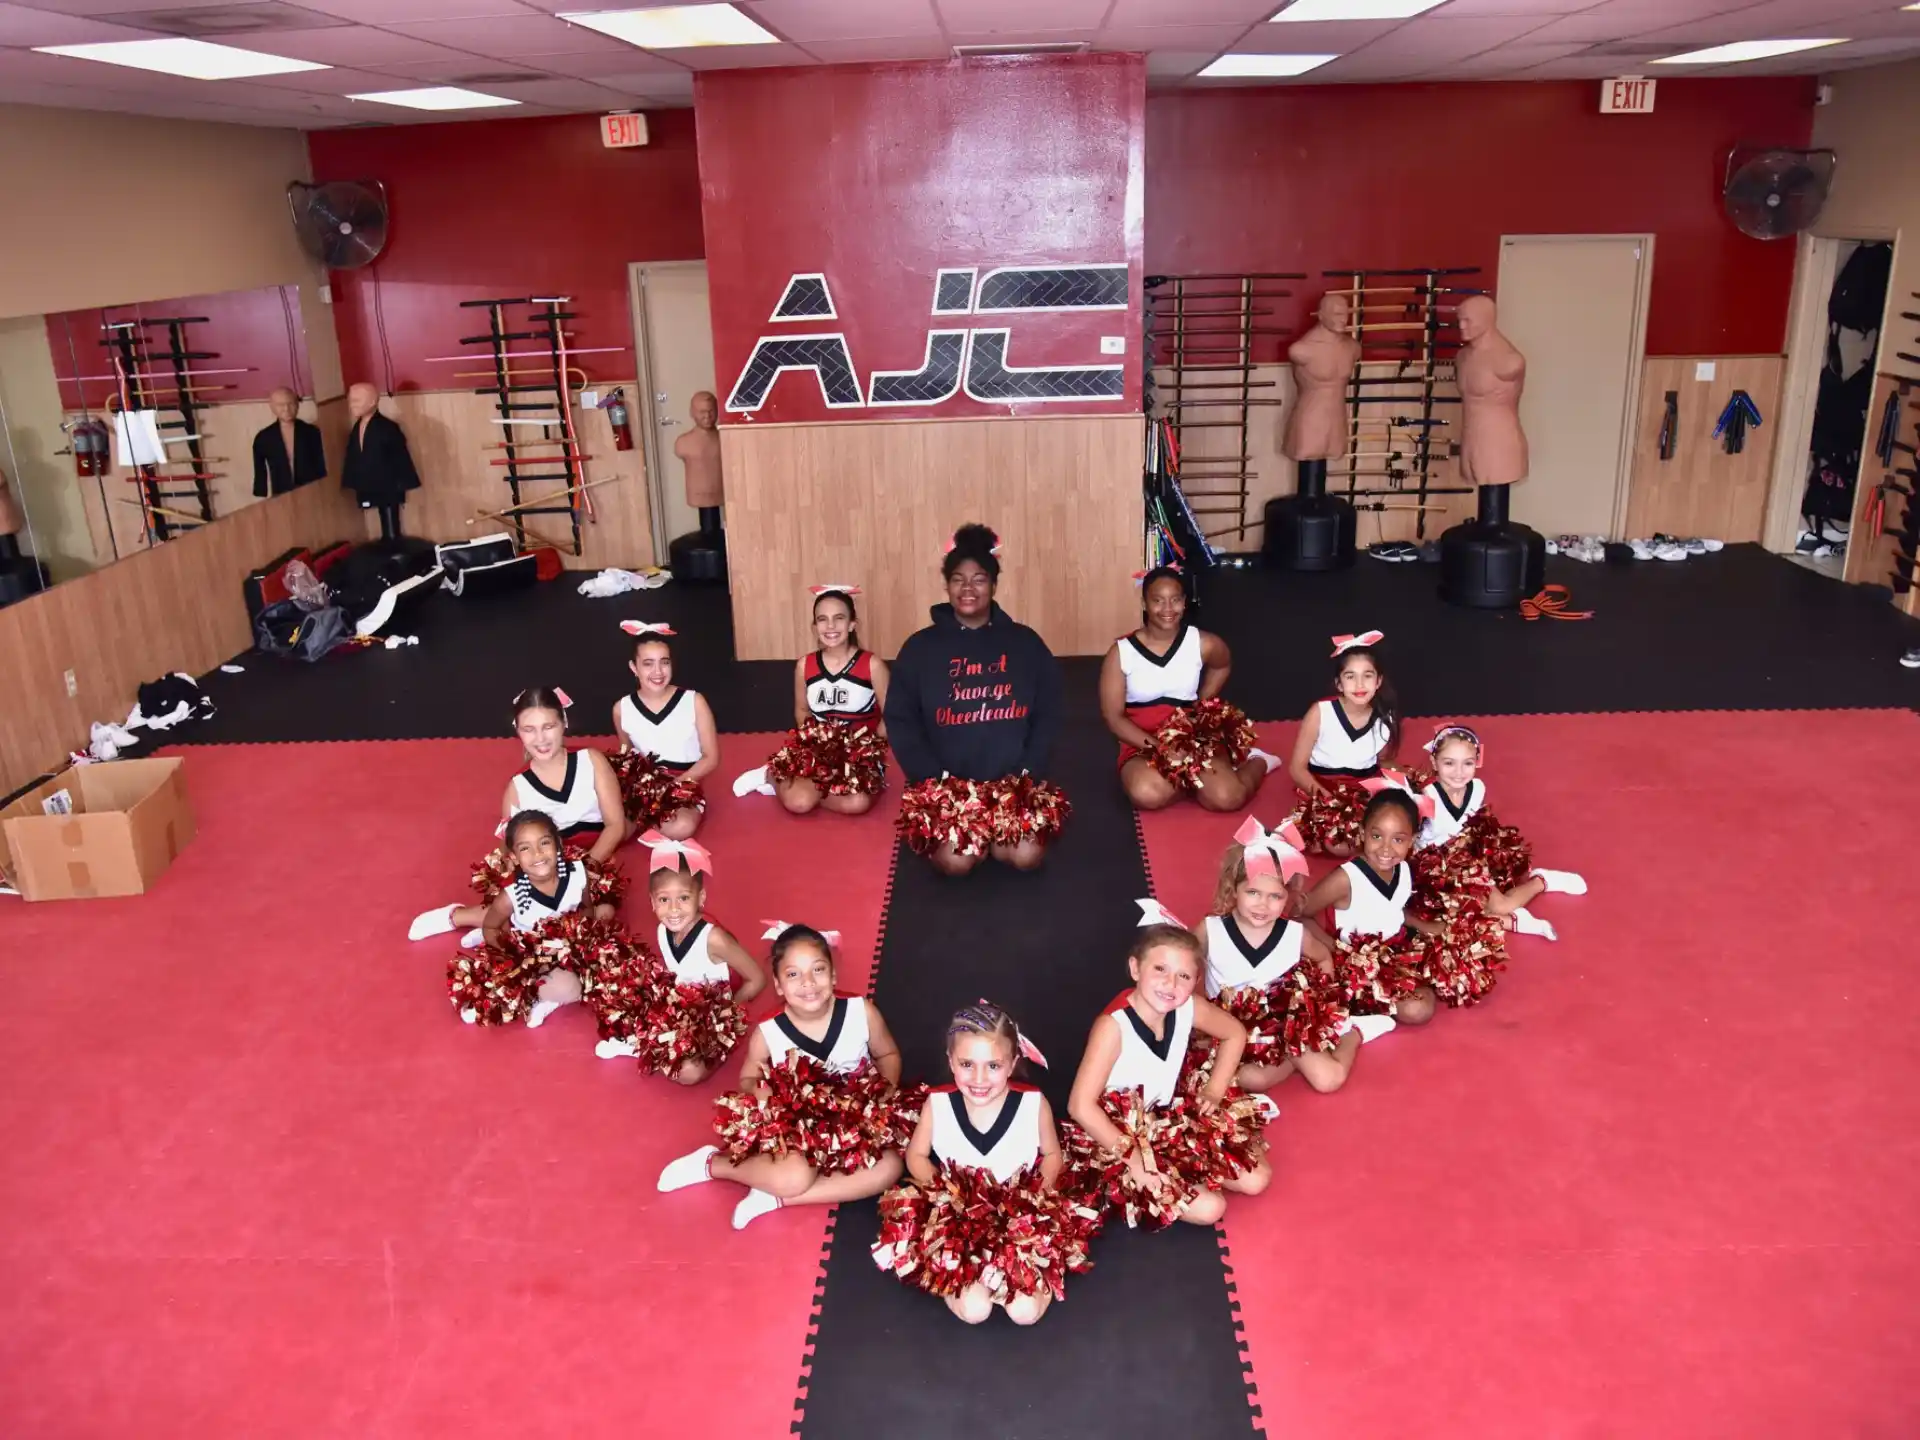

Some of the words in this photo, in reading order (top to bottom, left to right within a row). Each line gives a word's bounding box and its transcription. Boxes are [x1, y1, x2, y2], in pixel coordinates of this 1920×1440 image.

[1612, 81, 1649, 109] EXIT
[607, 115, 639, 145] EXIT
[725, 263, 1128, 412] AJC
[948, 656, 982, 677] I'm
[987, 653, 1007, 673] A
[815, 686, 849, 707] AJC
[949, 681, 1012, 701] Savage
[936, 699, 1028, 727] Cheerleader
